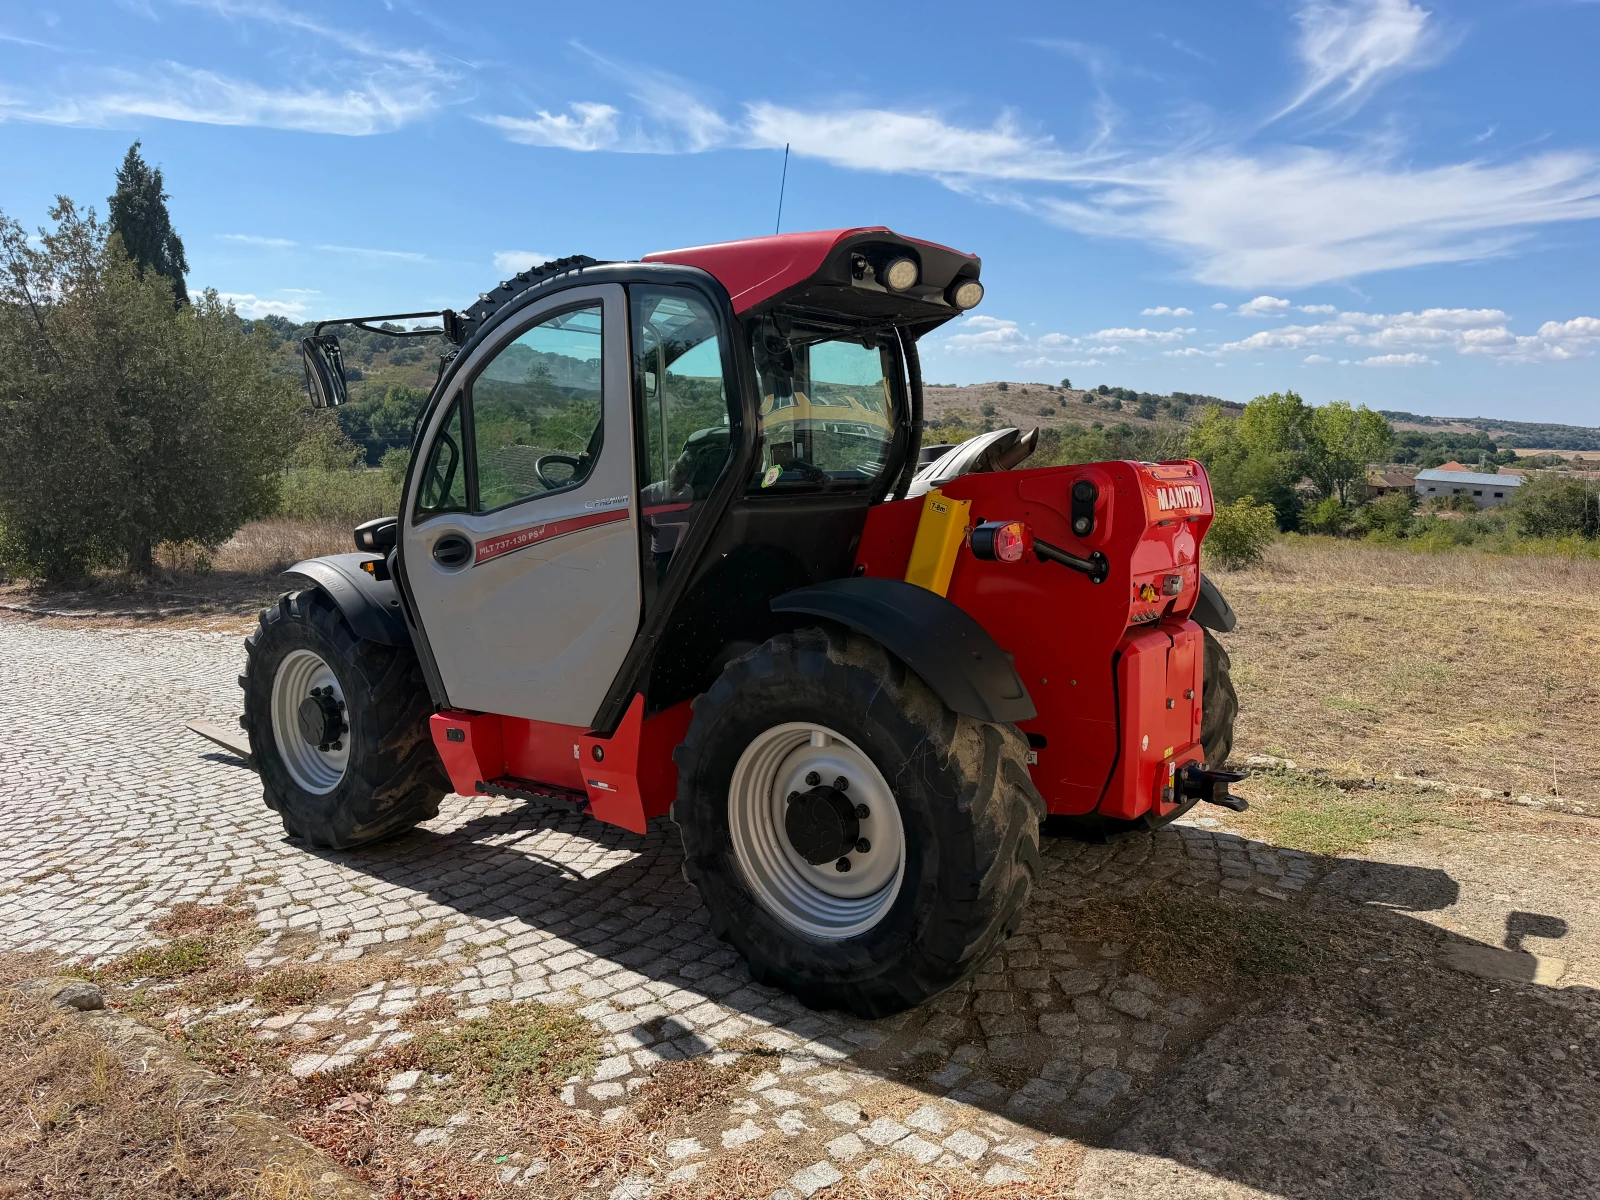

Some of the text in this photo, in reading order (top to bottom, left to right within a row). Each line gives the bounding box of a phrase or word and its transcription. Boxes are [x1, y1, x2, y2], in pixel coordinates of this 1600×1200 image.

[595, 495, 629, 507] PREMIUM
[479, 544, 495, 555] MLT
[495, 534, 527, 550] 737-130
